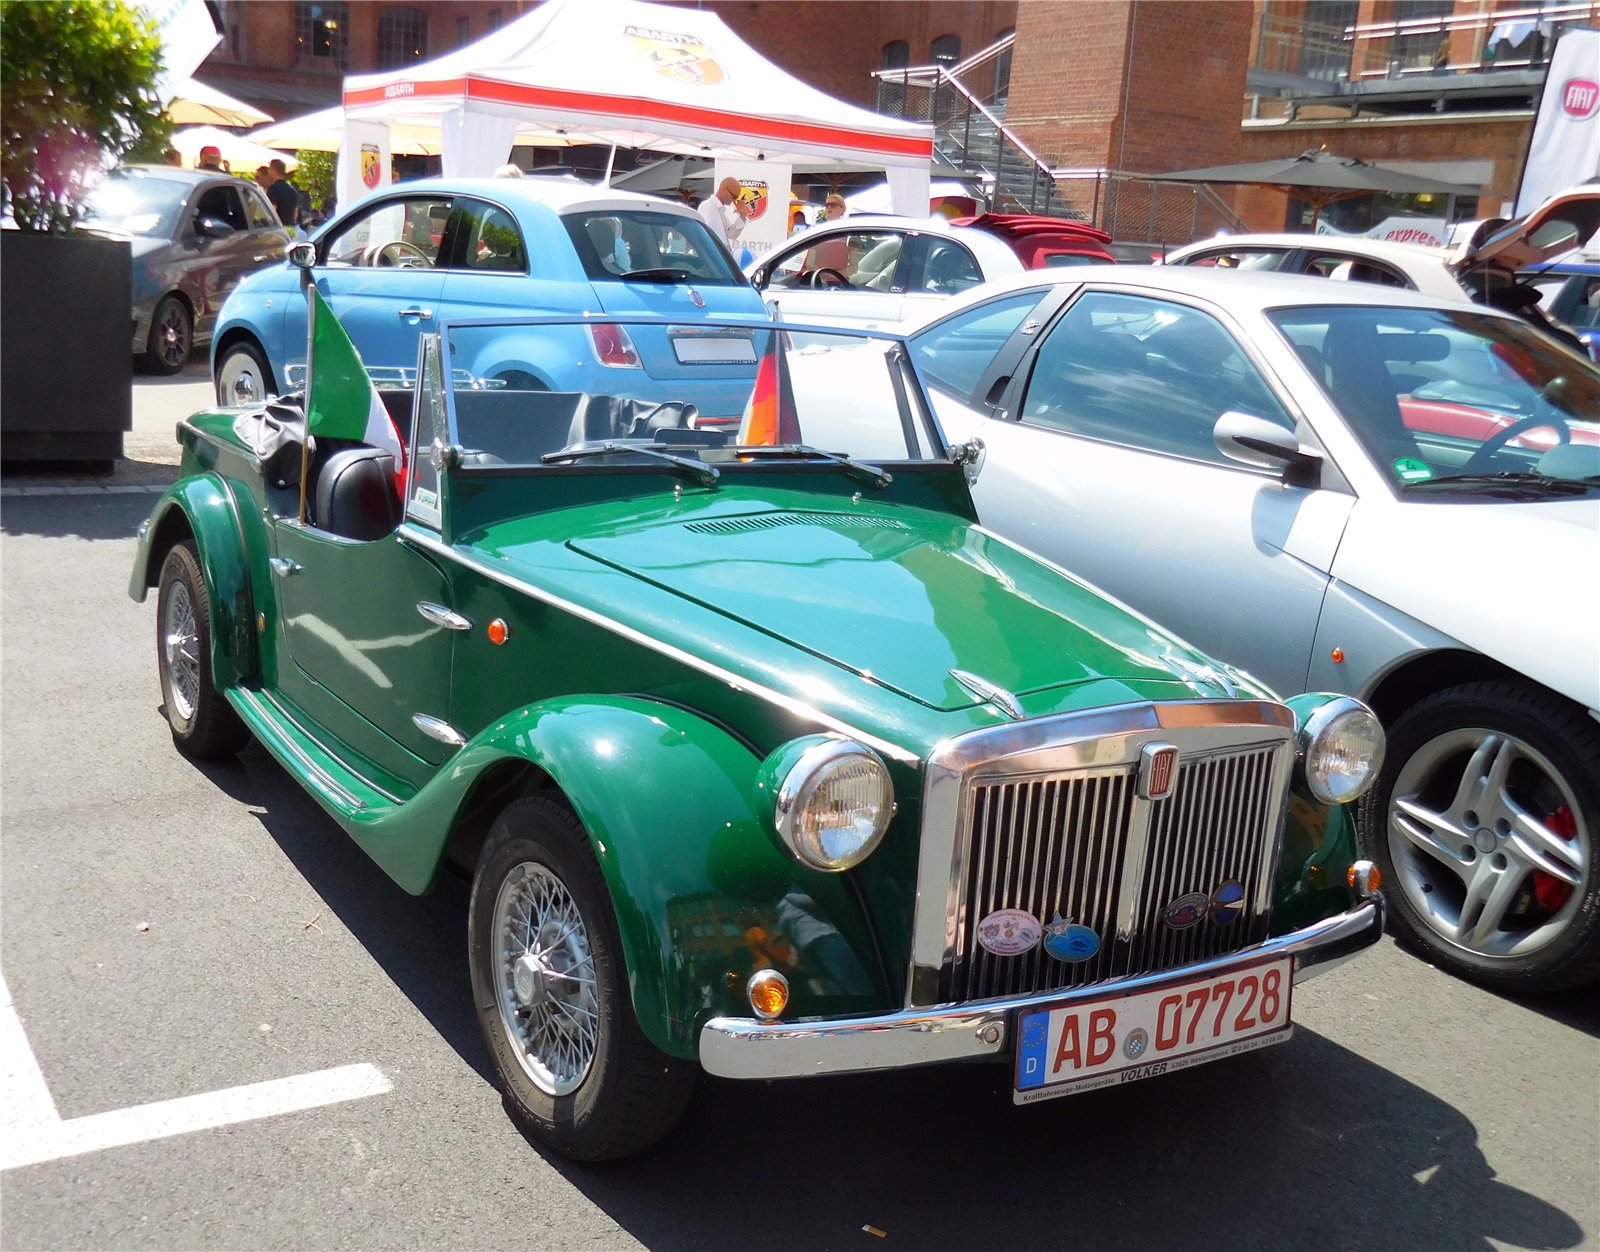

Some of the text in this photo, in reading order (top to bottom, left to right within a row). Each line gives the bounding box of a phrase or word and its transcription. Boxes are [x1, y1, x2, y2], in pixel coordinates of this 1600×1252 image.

[385, 82, 415, 98] ABARTH
[1566, 85, 1596, 110] FIAT
[731, 239, 773, 252] BARTH
[1151, 753, 1173, 793] FIAT
[1053, 969, 1281, 1073] AB 07728
[1025, 1057, 1037, 1074] D
[1120, 1062, 1168, 1083] VOLKER
